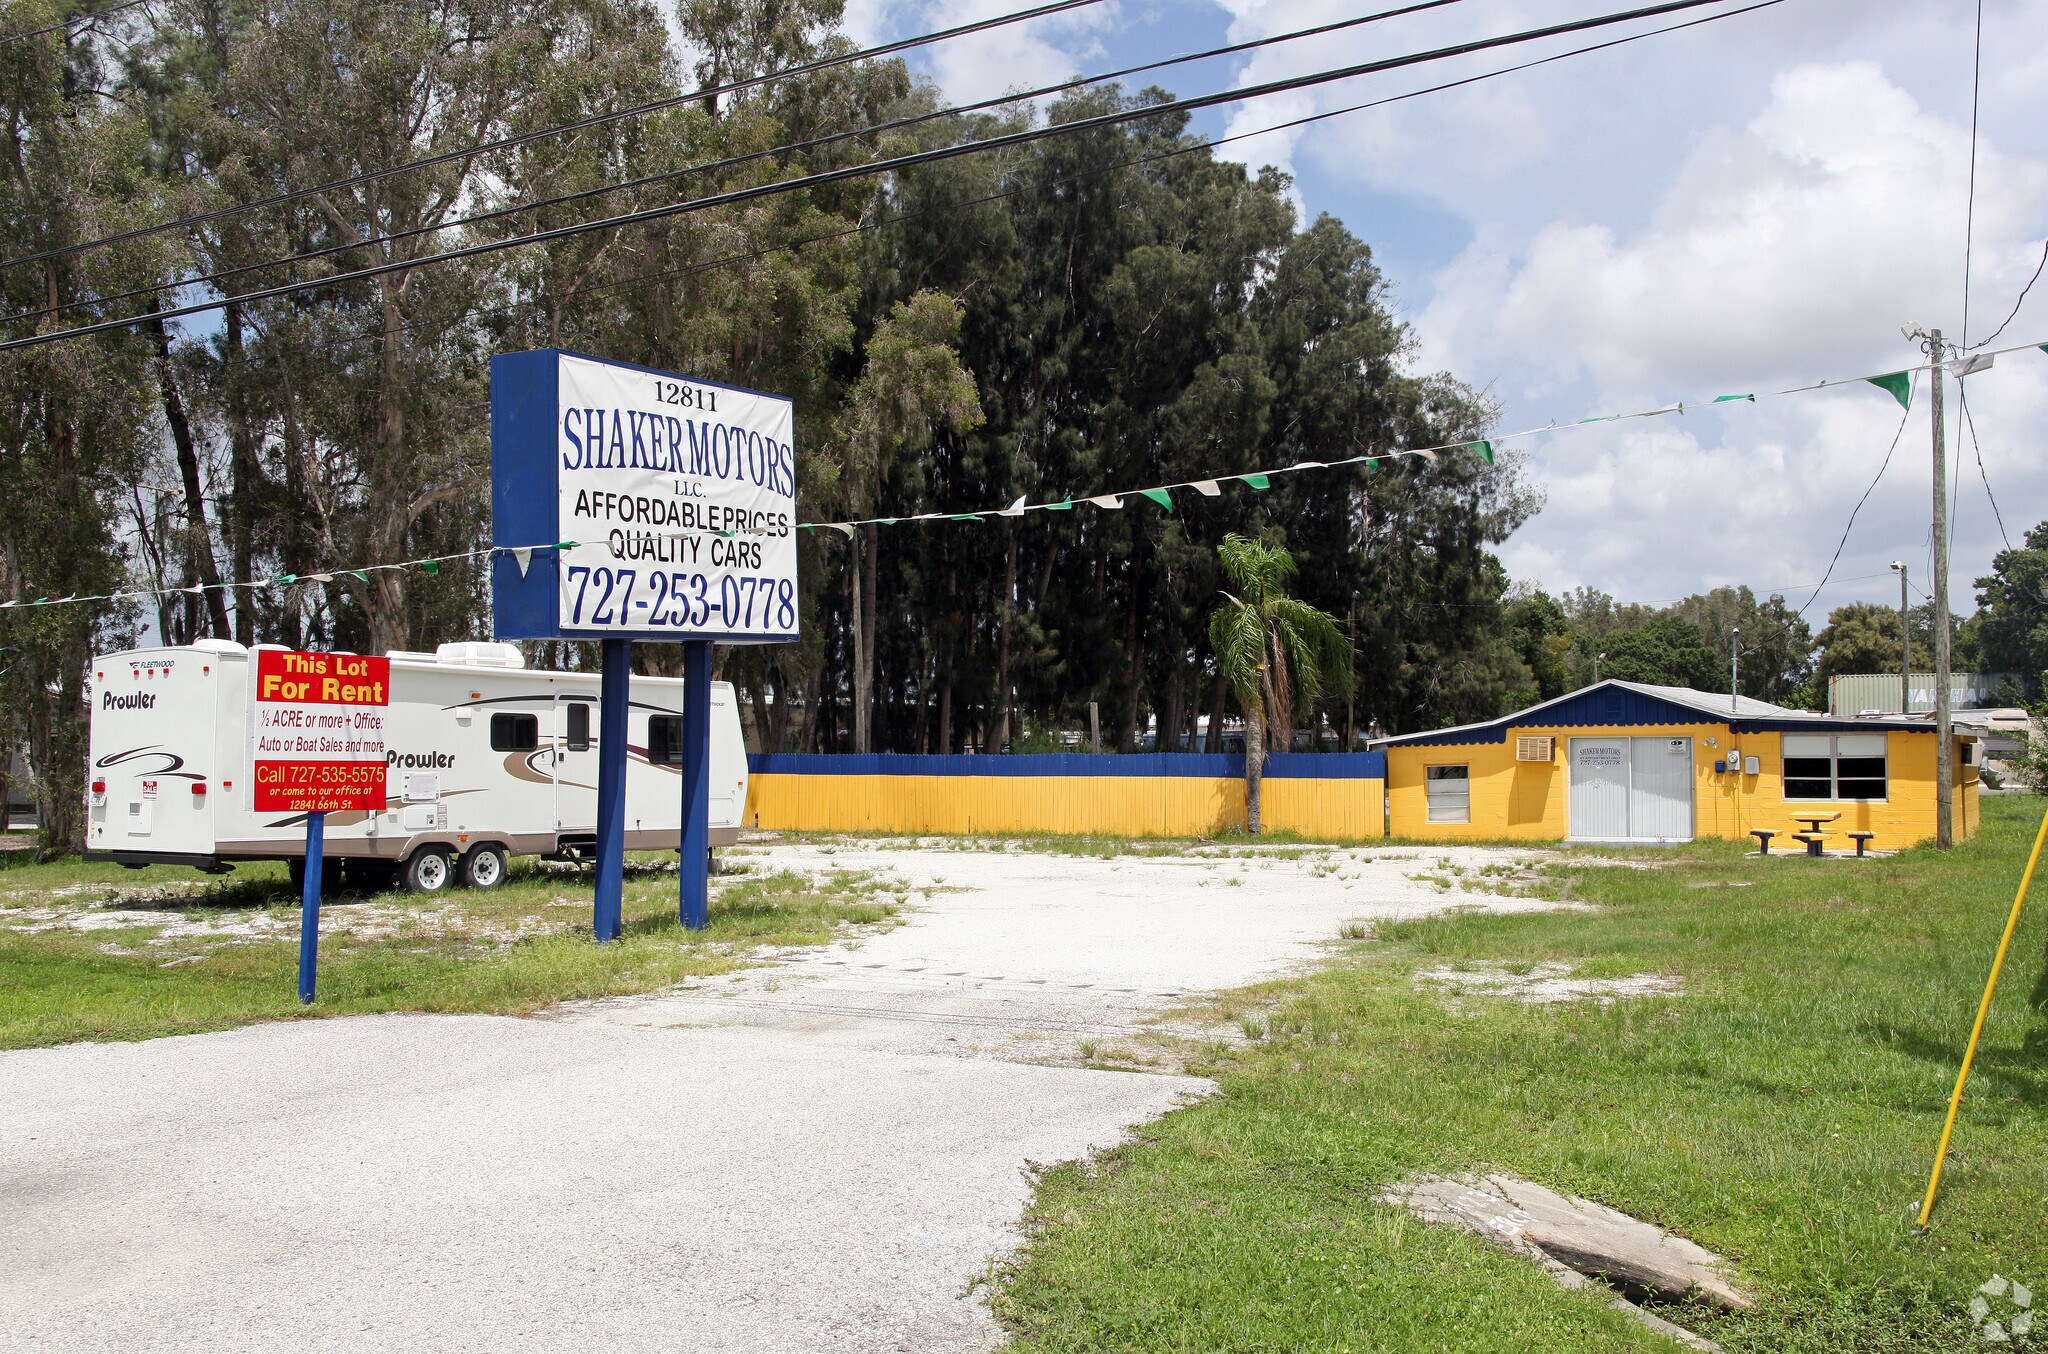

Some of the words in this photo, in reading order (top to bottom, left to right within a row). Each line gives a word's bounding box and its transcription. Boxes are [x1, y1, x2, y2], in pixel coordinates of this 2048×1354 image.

[654, 381, 717, 412] 12811
[674, 480, 706, 498] LLC.
[575, 489, 720, 531] AFFORDABLE
[724, 507, 788, 538] PRICES
[609, 529, 700, 564] QUALITY
[711, 539, 761, 569] CARS
[568, 566, 795, 629] 727-253-0778
[140, 660, 175, 668] FLEETWOOD
[283, 654, 326, 674] This
[337, 658, 368, 676] Lot
[264, 675, 309, 699] For
[322, 678, 382, 702] Rent
[103, 691, 155, 710] Prowler
[272, 710, 303, 727] ACRE
[306, 714, 316, 727] or
[318, 715, 342, 728] more
[355, 712, 383, 730] Office:
[259, 736, 281, 751] Auto
[284, 739, 294, 751] or
[296, 737, 318, 752] Boat
[320, 737, 342, 752] Sales
[345, 738, 361, 752] and
[363, 742, 384, 752] more
[387, 750, 455, 768] Prowler
[257, 766, 285, 782] Call
[290, 766, 384, 782] 727-535-5575
[270, 787, 280, 796] or
[283, 787, 304, 796] come
[308, 787, 316, 795] to
[319, 787, 333, 795] our
[336, 786, 361, 795] office
[363, 786, 373, 795] at
[290, 800, 315, 809] 12841
[318, 800, 338, 809] 66th
[341, 800, 353, 809] St.
